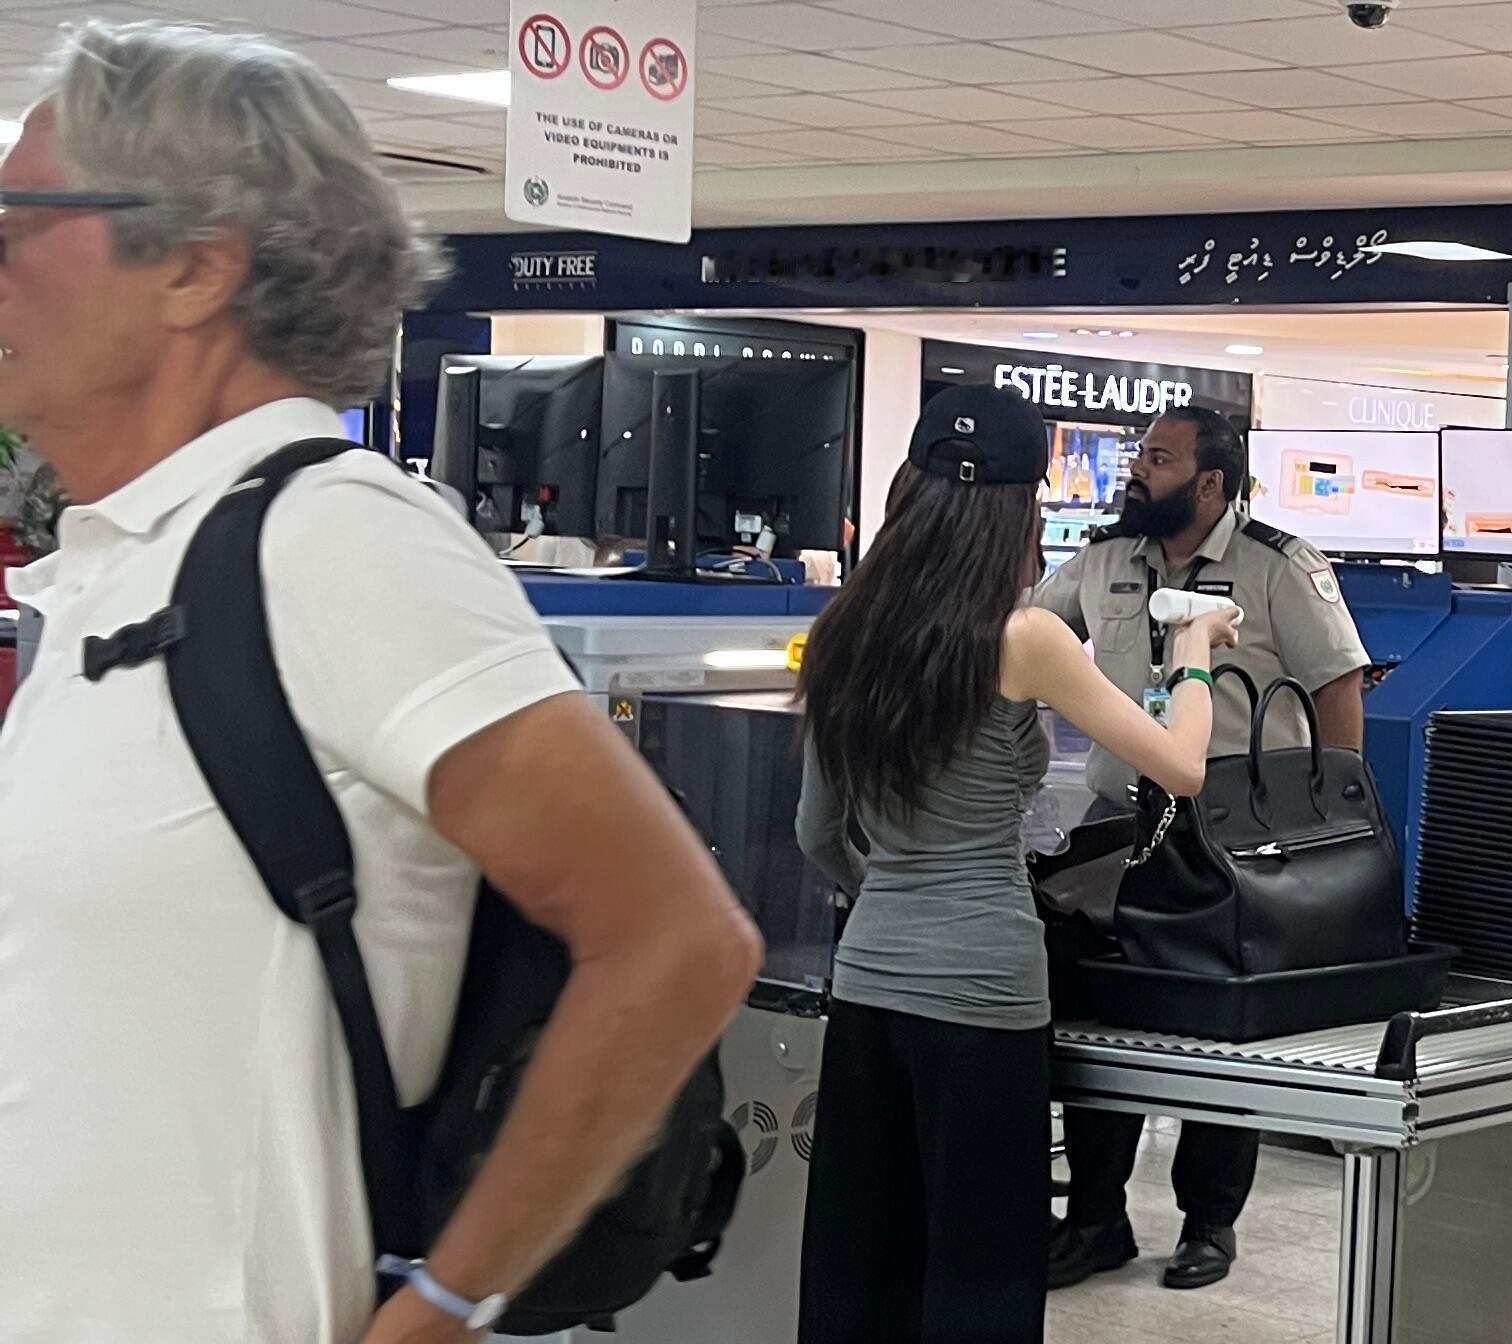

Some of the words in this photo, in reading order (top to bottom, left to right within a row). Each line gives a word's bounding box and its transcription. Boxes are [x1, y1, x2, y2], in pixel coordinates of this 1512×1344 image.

[536, 111, 559, 126] THE
[562, 116, 585, 130] USE
[588, 120, 603, 132] OF
[606, 123, 660, 142] CAMERAS
[662, 132, 678, 145] OR
[544, 131, 580, 146] VIDEO
[583, 137, 655, 159] EQUIPMENTS
[658, 149, 669, 161] IS
[573, 153, 642, 173] PROHIBITED
[512, 255, 554, 277] DUTY
[557, 255, 596, 276] FREE
[1082, 373, 1192, 413] LAUDER
[1349, 397, 1435, 429] CLINIQUE
